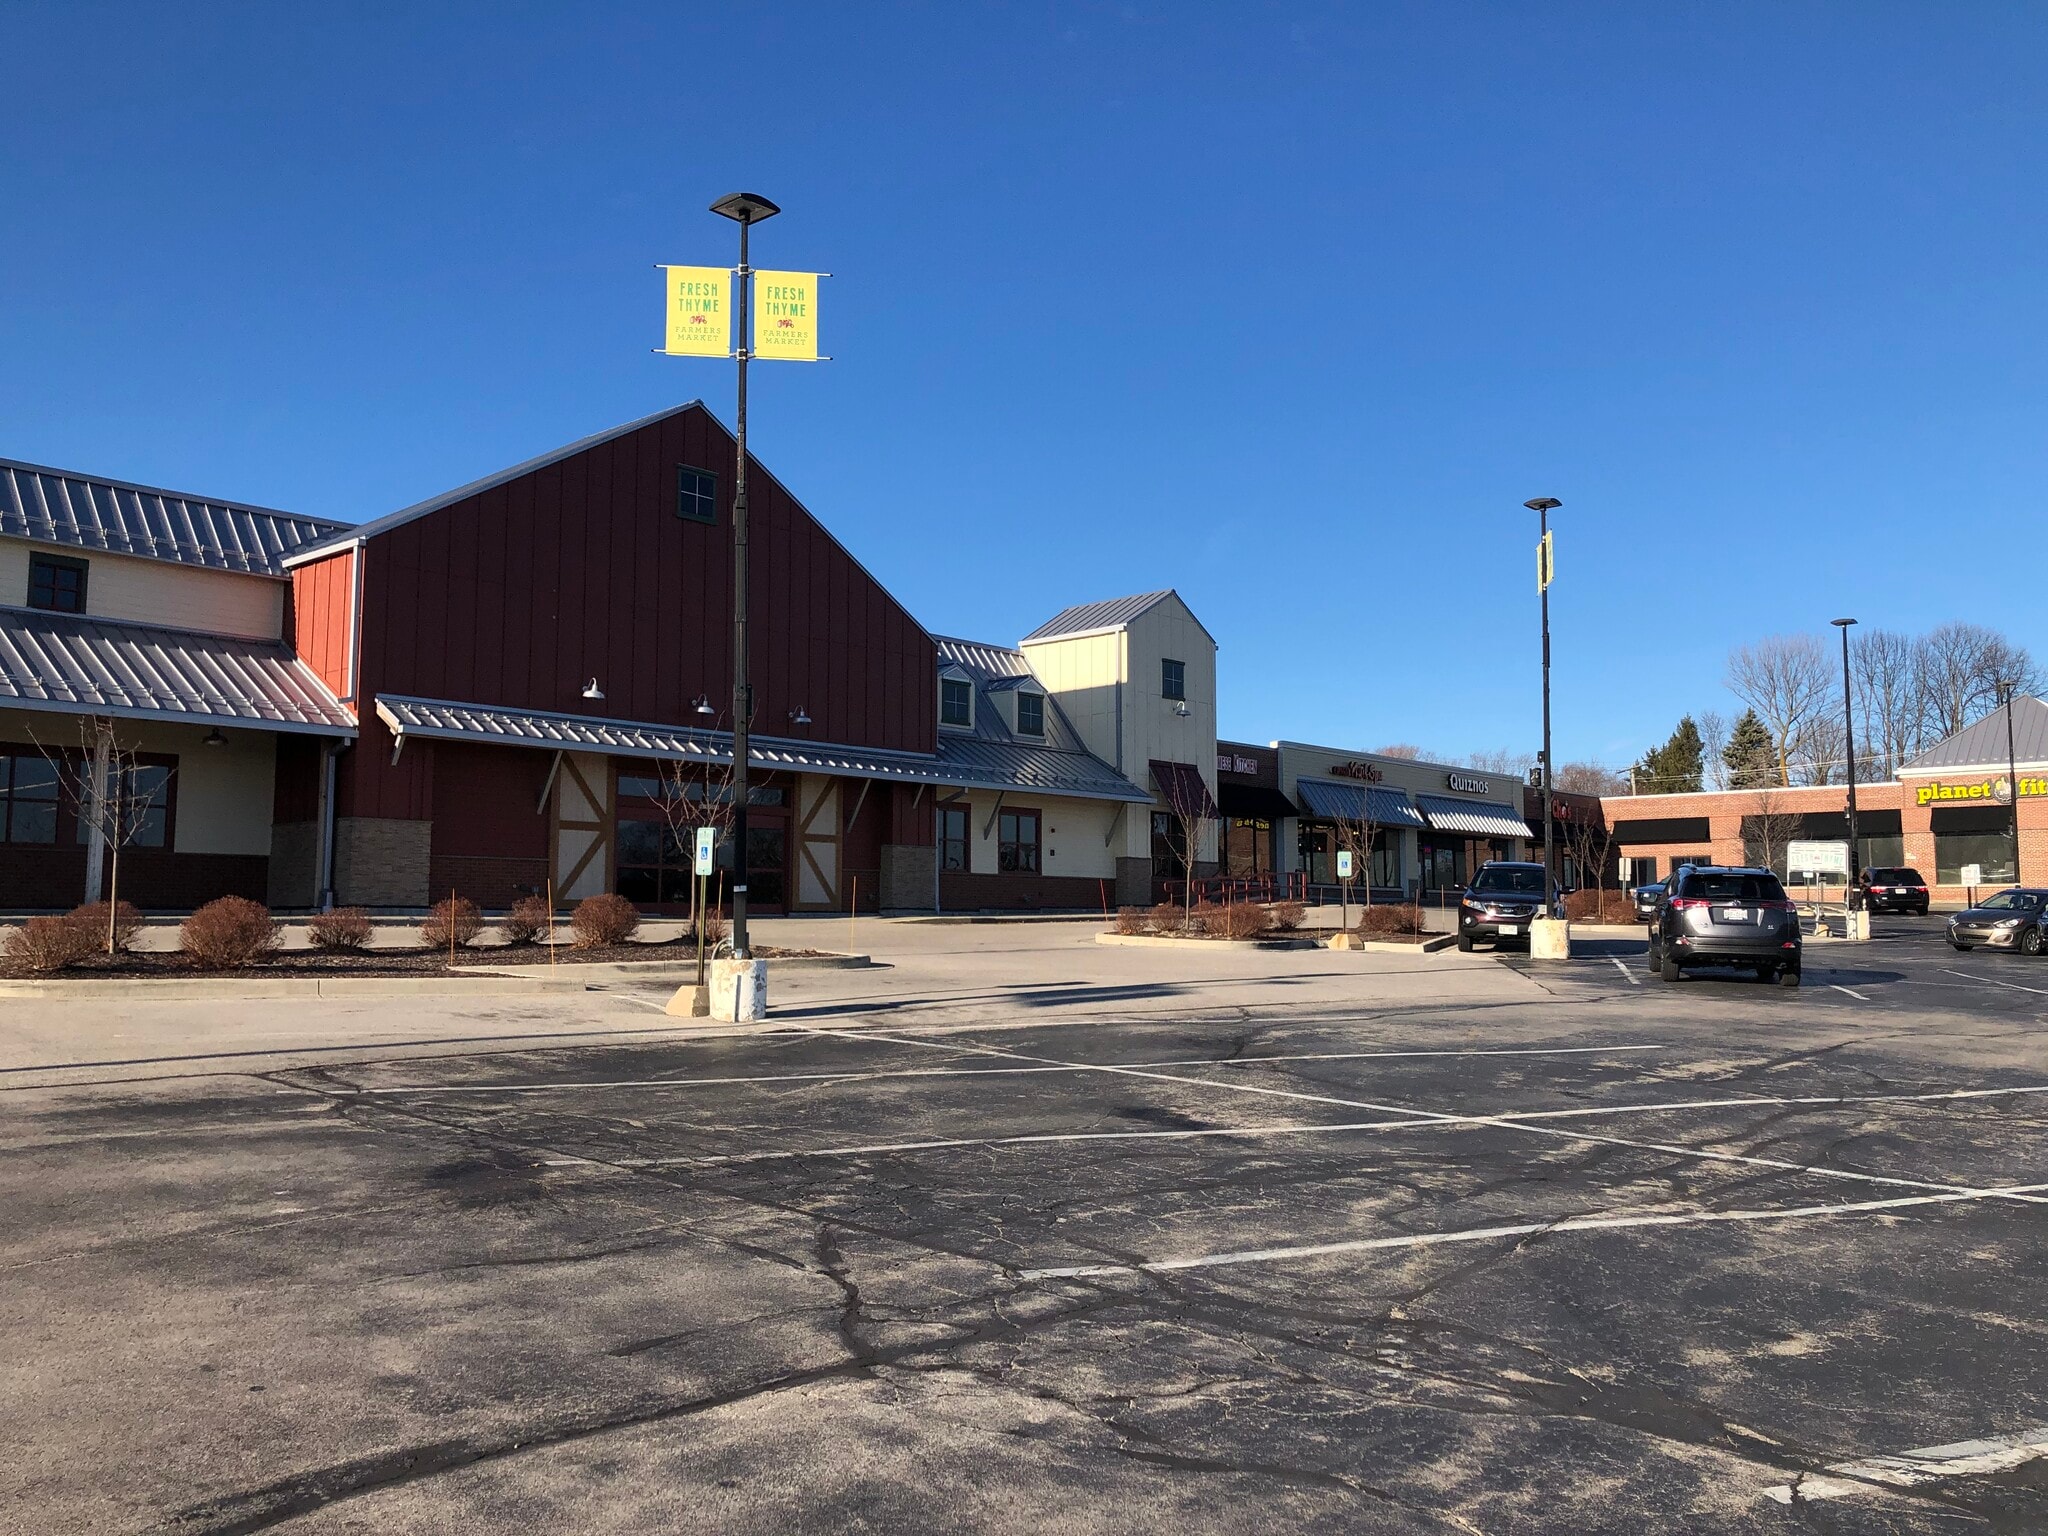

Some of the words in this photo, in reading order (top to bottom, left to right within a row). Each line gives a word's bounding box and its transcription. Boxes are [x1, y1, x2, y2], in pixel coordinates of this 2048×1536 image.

[679, 282, 718, 297] FRESH
[767, 286, 805, 301] FRESH
[678, 298, 719, 313] THYME
[766, 302, 806, 317] THYME
[675, 326, 721, 335] FARMERS
[677, 334, 719, 342] MARKET
[763, 330, 809, 339] FARMERS
[765, 337, 806, 346] MARKET
[1917, 781, 1991, 805] planet
[2018, 778, 2048, 796] fit
